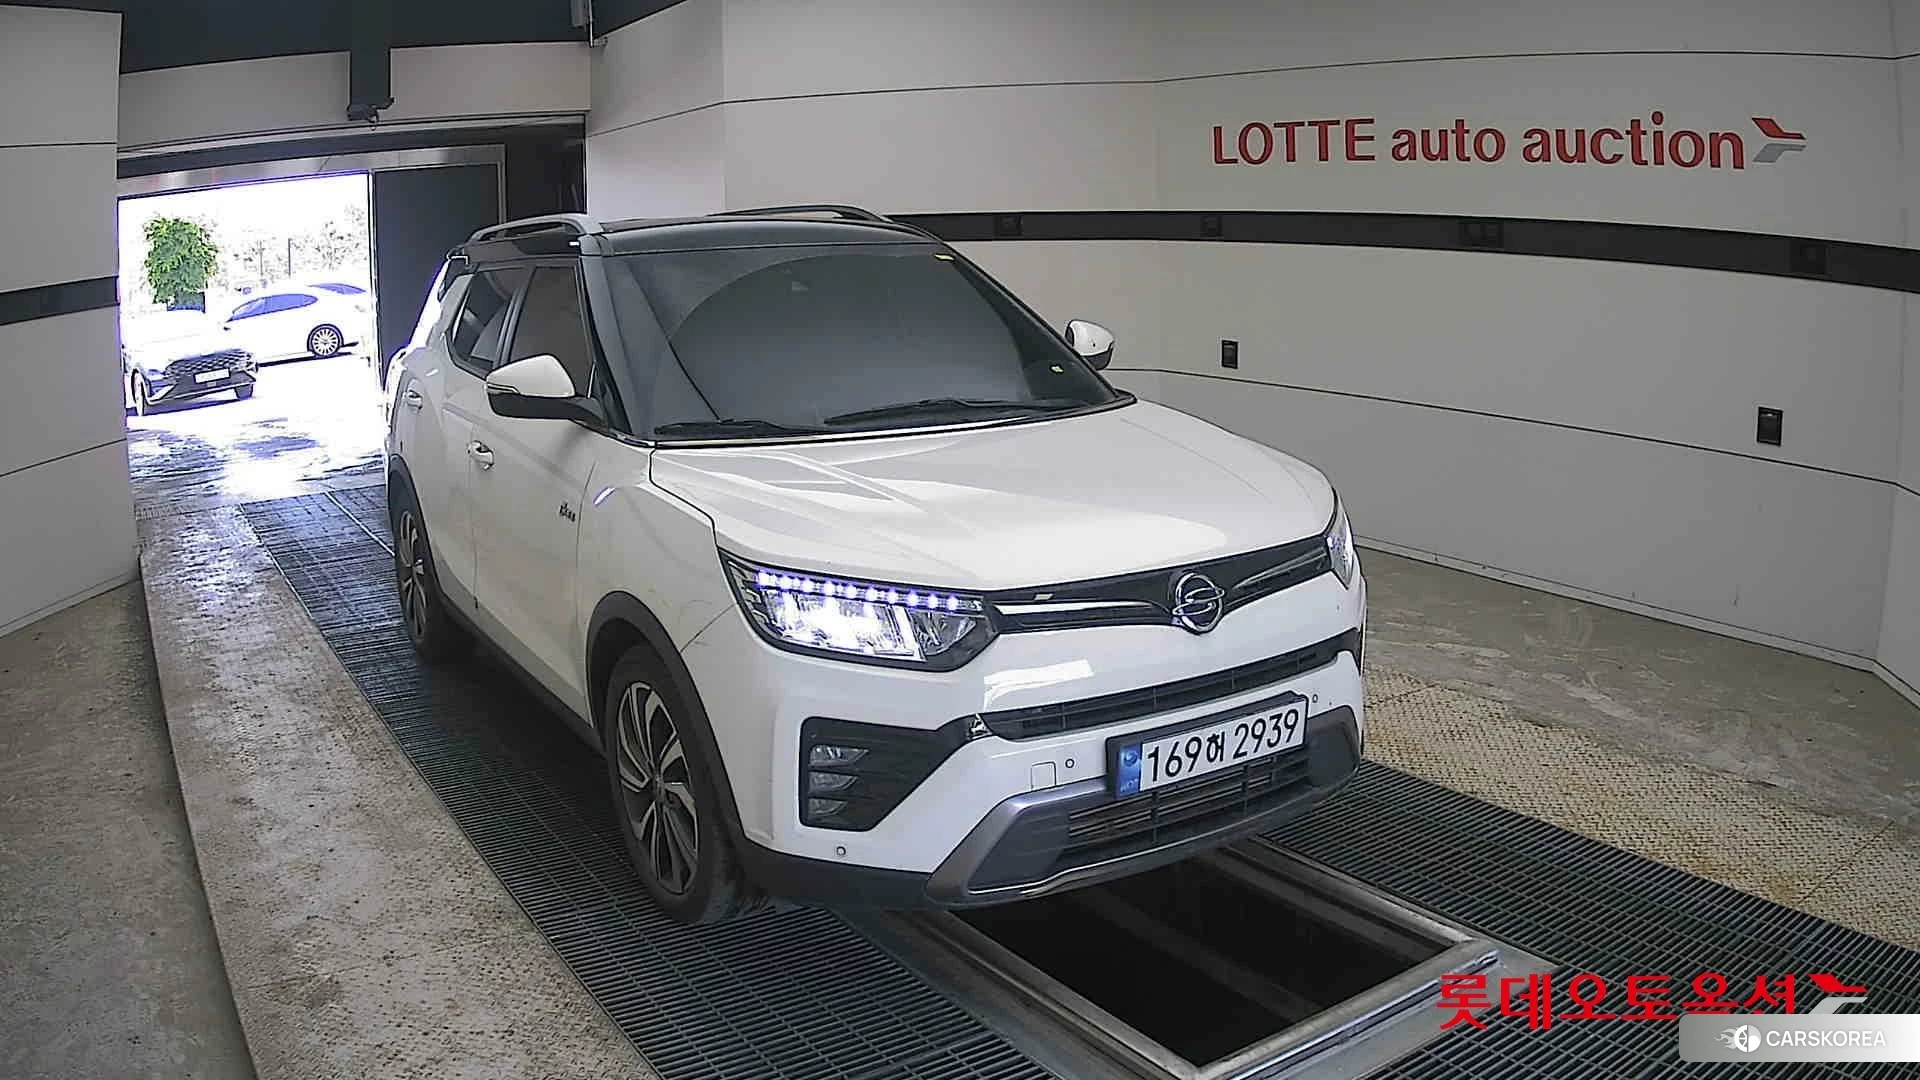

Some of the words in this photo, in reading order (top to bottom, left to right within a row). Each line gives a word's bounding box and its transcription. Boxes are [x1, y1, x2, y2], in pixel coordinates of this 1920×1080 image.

[1213, 118, 1375, 164] LOTTE
[1391, 118, 1506, 162] auto
[1522, 111, 1745, 169] auction
[1232, 708, 1299, 760] 2939
